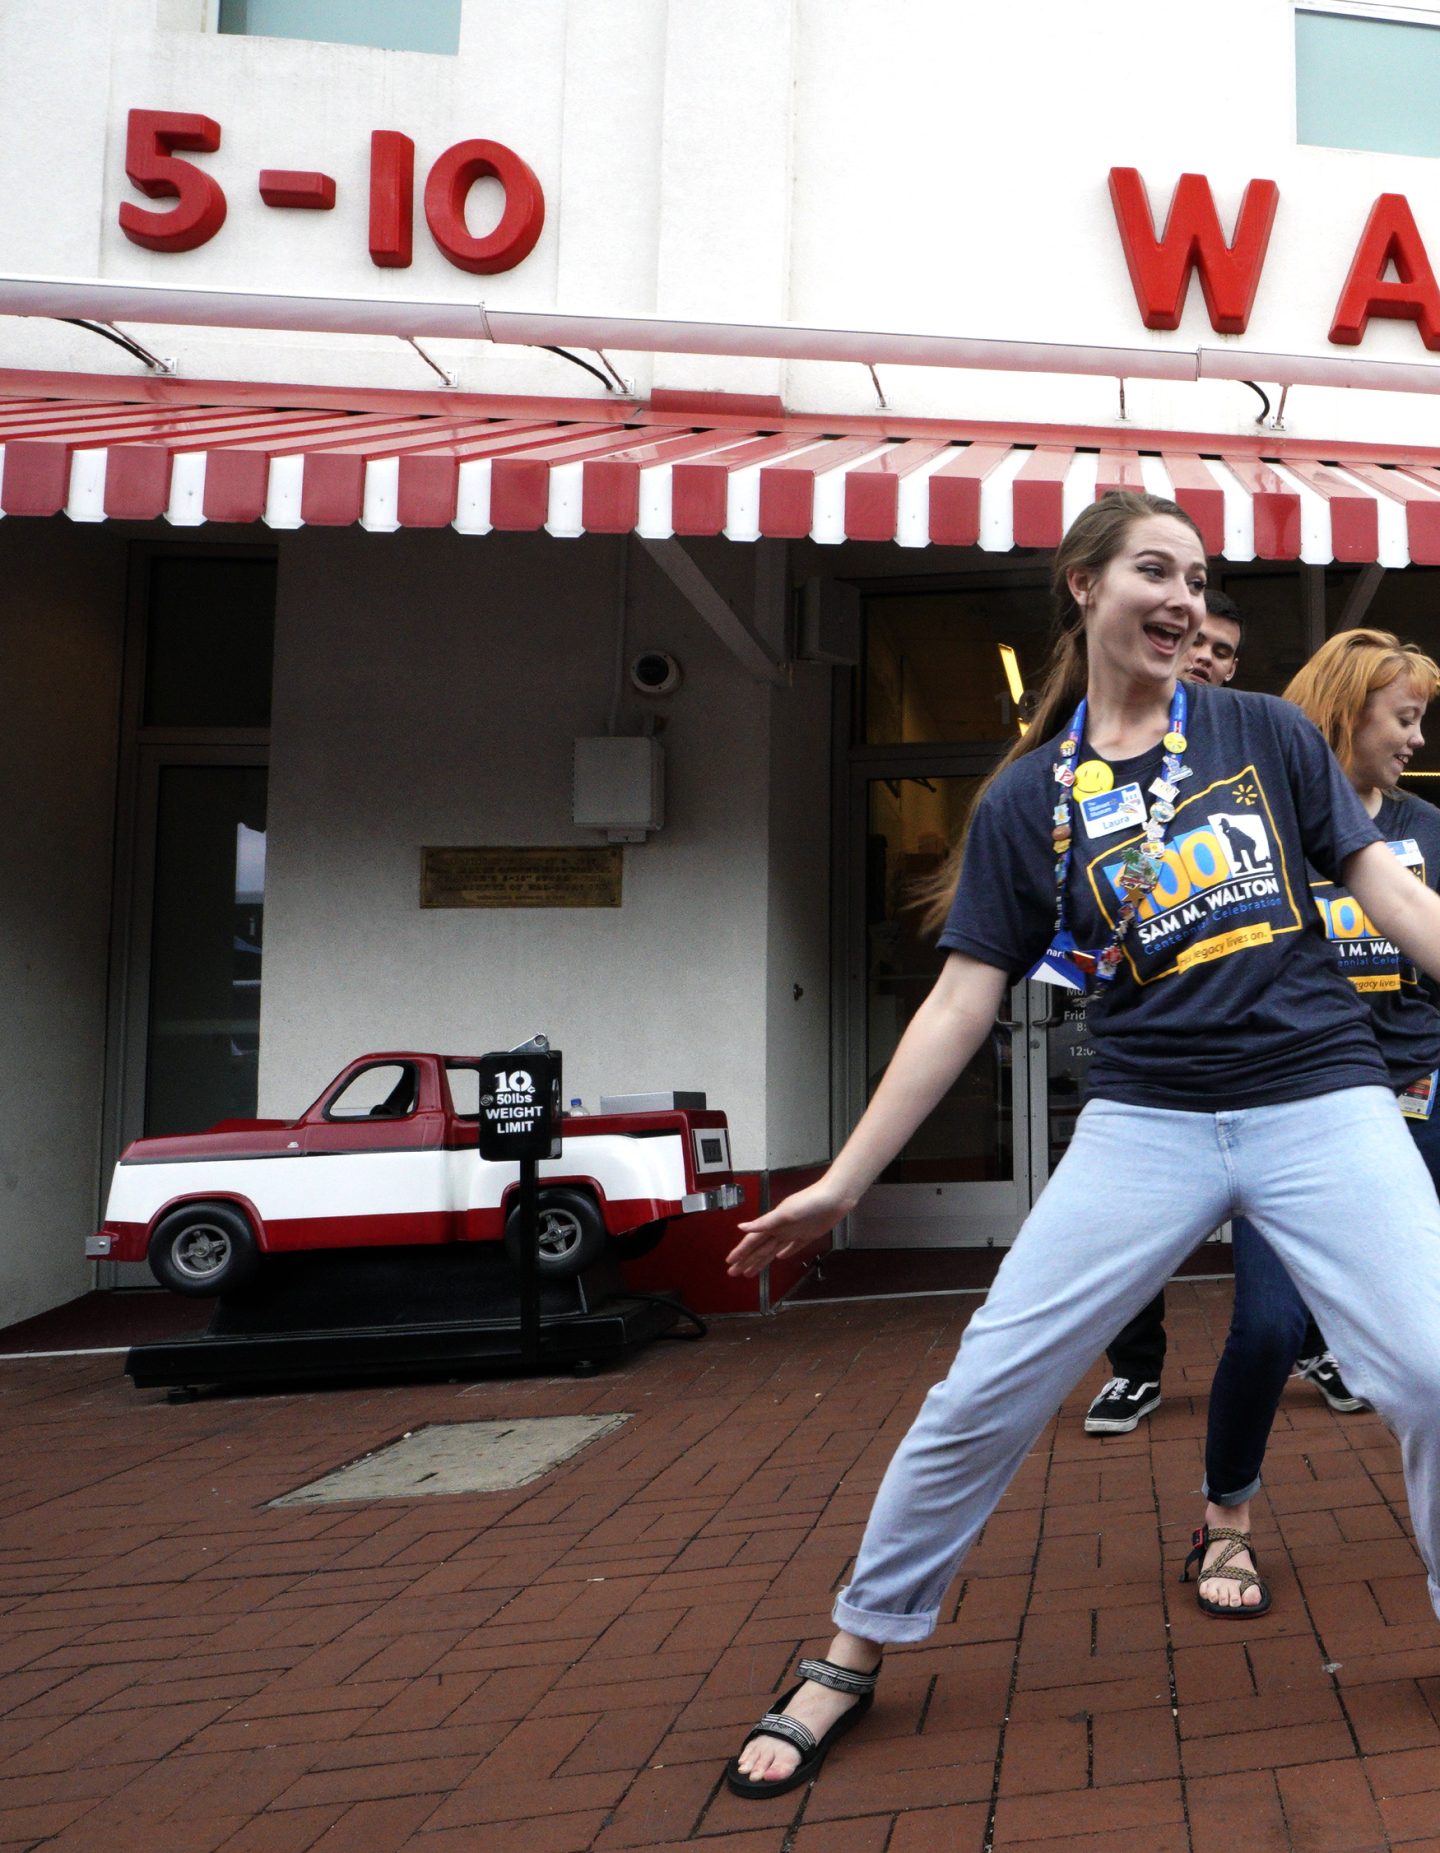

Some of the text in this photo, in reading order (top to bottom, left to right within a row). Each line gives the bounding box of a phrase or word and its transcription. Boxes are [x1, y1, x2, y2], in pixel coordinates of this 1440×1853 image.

[119, 108, 545, 275] 5-10
[1102, 816, 1131, 829] Laura
[1138, 877, 1280, 944] SAM M. WALTON
[1143, 896, 1282, 955] Centennial Celebration
[1193, 942, 1225, 959] legacy
[1226, 934, 1249, 948] lives
[1348, 943, 1368, 957] M.
[496, 1093, 532, 1105] 50lbs
[486, 1105, 543, 1120] WEIGHT
[496, 1121, 534, 1134] LIMIT
